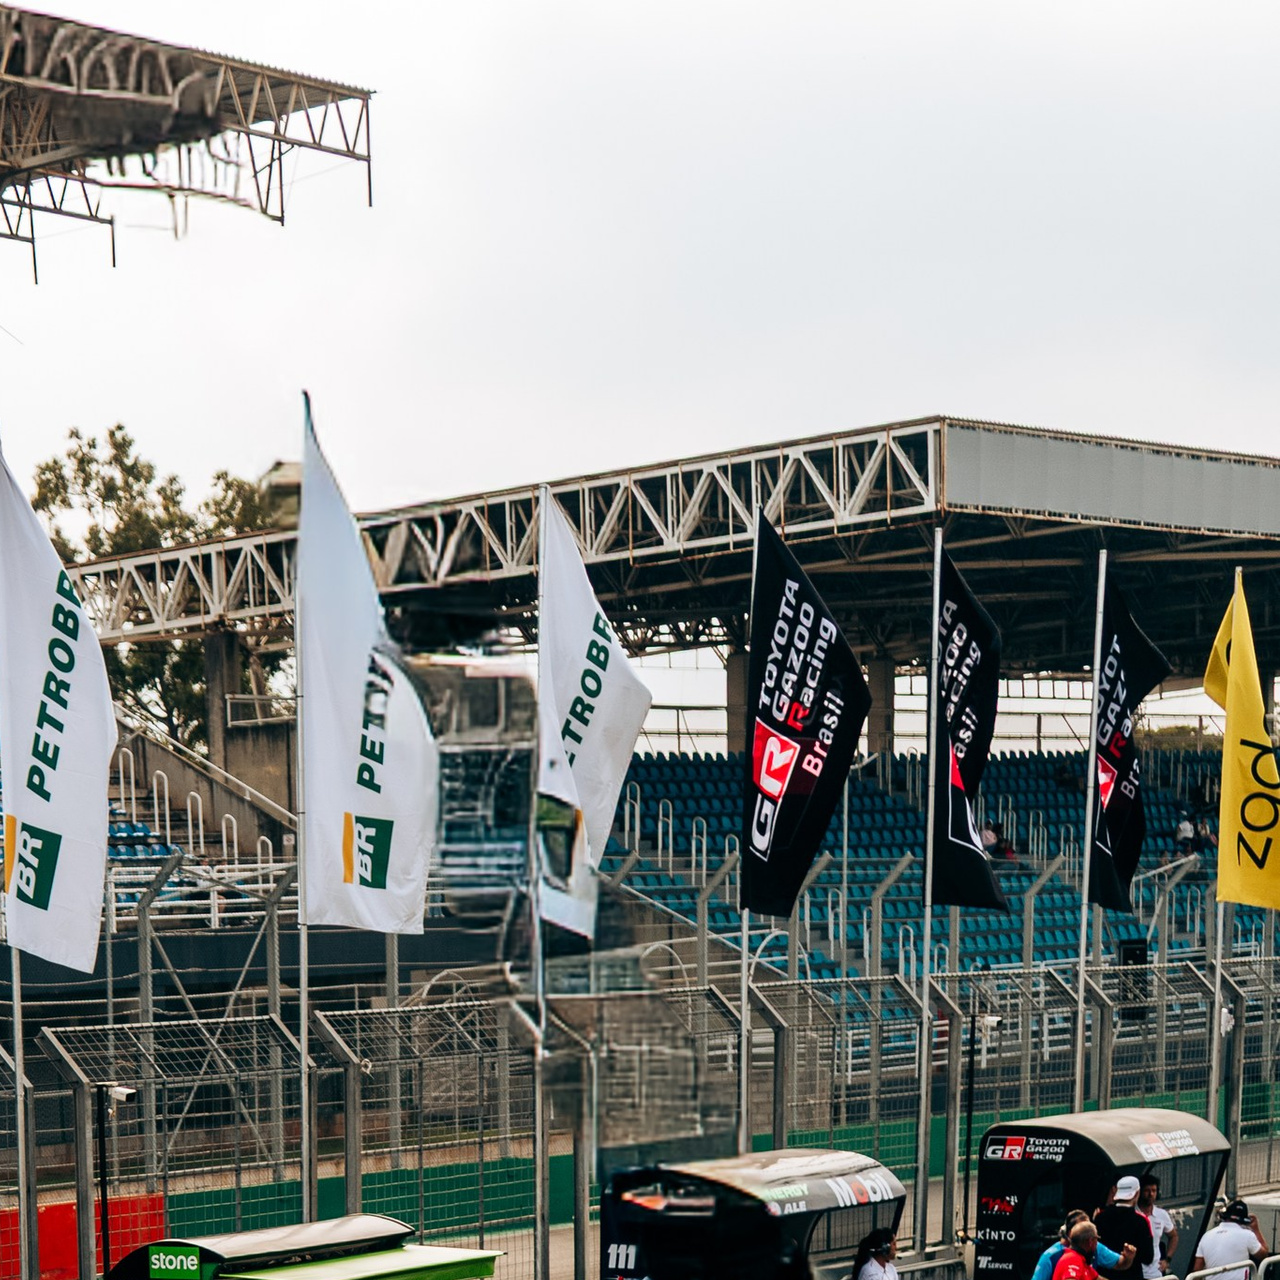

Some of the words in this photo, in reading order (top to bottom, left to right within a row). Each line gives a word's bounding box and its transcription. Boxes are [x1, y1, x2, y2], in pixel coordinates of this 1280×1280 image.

[759, 578, 800, 710] TOYOTA
[771, 601, 814, 723] GAZOO
[940, 621, 968, 699] ZOO
[787, 616, 838, 732] Racing
[802, 690, 845, 778] Brasil
[1097, 669, 1128, 747] GAZ
[1109, 707, 1134, 759] Ra
[750, 732, 797, 854] GR
[17, 827, 47, 902] BR
[356, 820, 381, 885] BR
[985, 1143, 1023, 1160] GR
[1025, 1144, 1066, 1154] GAZOO
[1025, 1152, 1063, 1163] Racing
[1028, 1137, 1070, 1147] TOYOTA
[783, 1200, 807, 1214] ALE
[825, 1172, 895, 1208] Mobil
[151, 1252, 198, 1271] stone
[607, 1243, 637, 1270] 111
